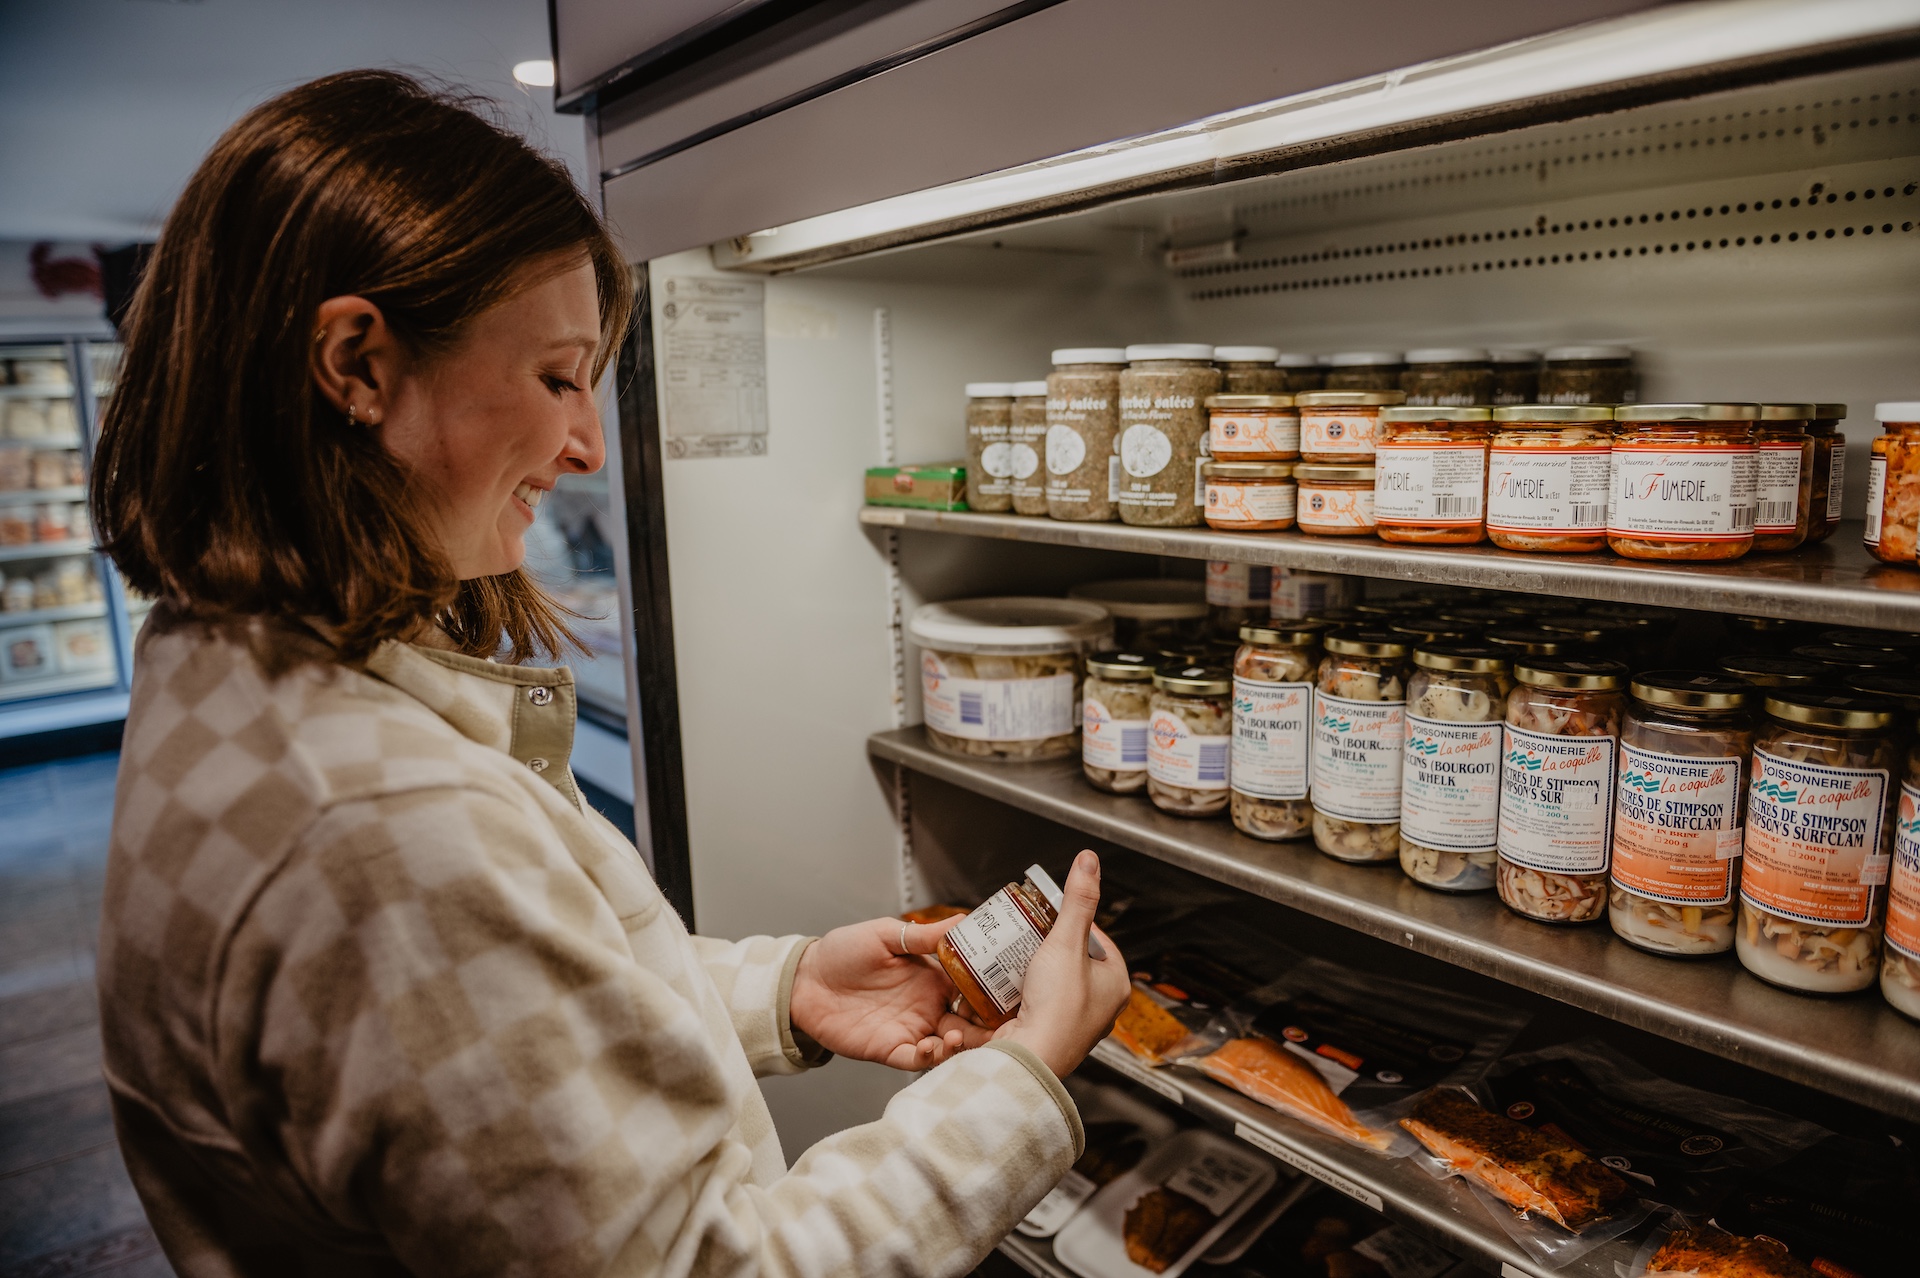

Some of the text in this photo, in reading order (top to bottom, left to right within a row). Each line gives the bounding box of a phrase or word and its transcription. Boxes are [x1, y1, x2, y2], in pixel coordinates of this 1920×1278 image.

[1620, 455, 1729, 468] Saumon Fumé mariné
[1496, 472, 1544, 499] FUMERIE
[1624, 478, 1635, 499] LA
[1638, 473, 1706, 501] FUMERIE
[1326, 704, 1387, 718] POISSONNERIE
[1248, 717, 1302, 731] (BOURGOT)
[1352, 720, 1364, 733] La
[1413, 725, 1478, 740] POISSONNERIE
[1239, 727, 1267, 740] WHELK
[1440, 731, 1493, 758] La coquille
[1513, 738, 1586, 756] POISSONNERIE
[1331, 747, 1366, 762] WHELK
[1542, 746, 1603, 774] La coquille
[1431, 760, 1495, 776] (BOURGOT)
[1629, 757, 1708, 778] POISSONNERIE
[1418, 771, 1456, 787] WHELK
[1530, 774, 1543, 789] DE
[1661, 767, 1727, 798] La coquille
[1764, 765, 1852, 790] POISSONNERIE
[1798, 780, 1872, 811] La coquille
[1647, 797, 1661, 812] DE
[1665, 800, 1724, 817] STIMPSON
[1658, 813, 1722, 831] SURFCLAM
[1781, 808, 1797, 824] DE
[1802, 812, 1867, 833] STIMPSON
[1657, 828, 1667, 836] IN
[1750, 825, 1838, 855] SAUMURE IN BRINE
[1793, 826, 1864, 848] SURFCLAM
[1663, 838, 1680, 846] 200
[1682, 841, 1689, 849] g
[1798, 853, 1816, 862] 200
[1819, 857, 1826, 866] g
[1772, 892, 1818, 909] POISSONNERIE
[1829, 904, 1860, 912] COQUILLE
[1355, 1189, 1369, 1203] Bay
